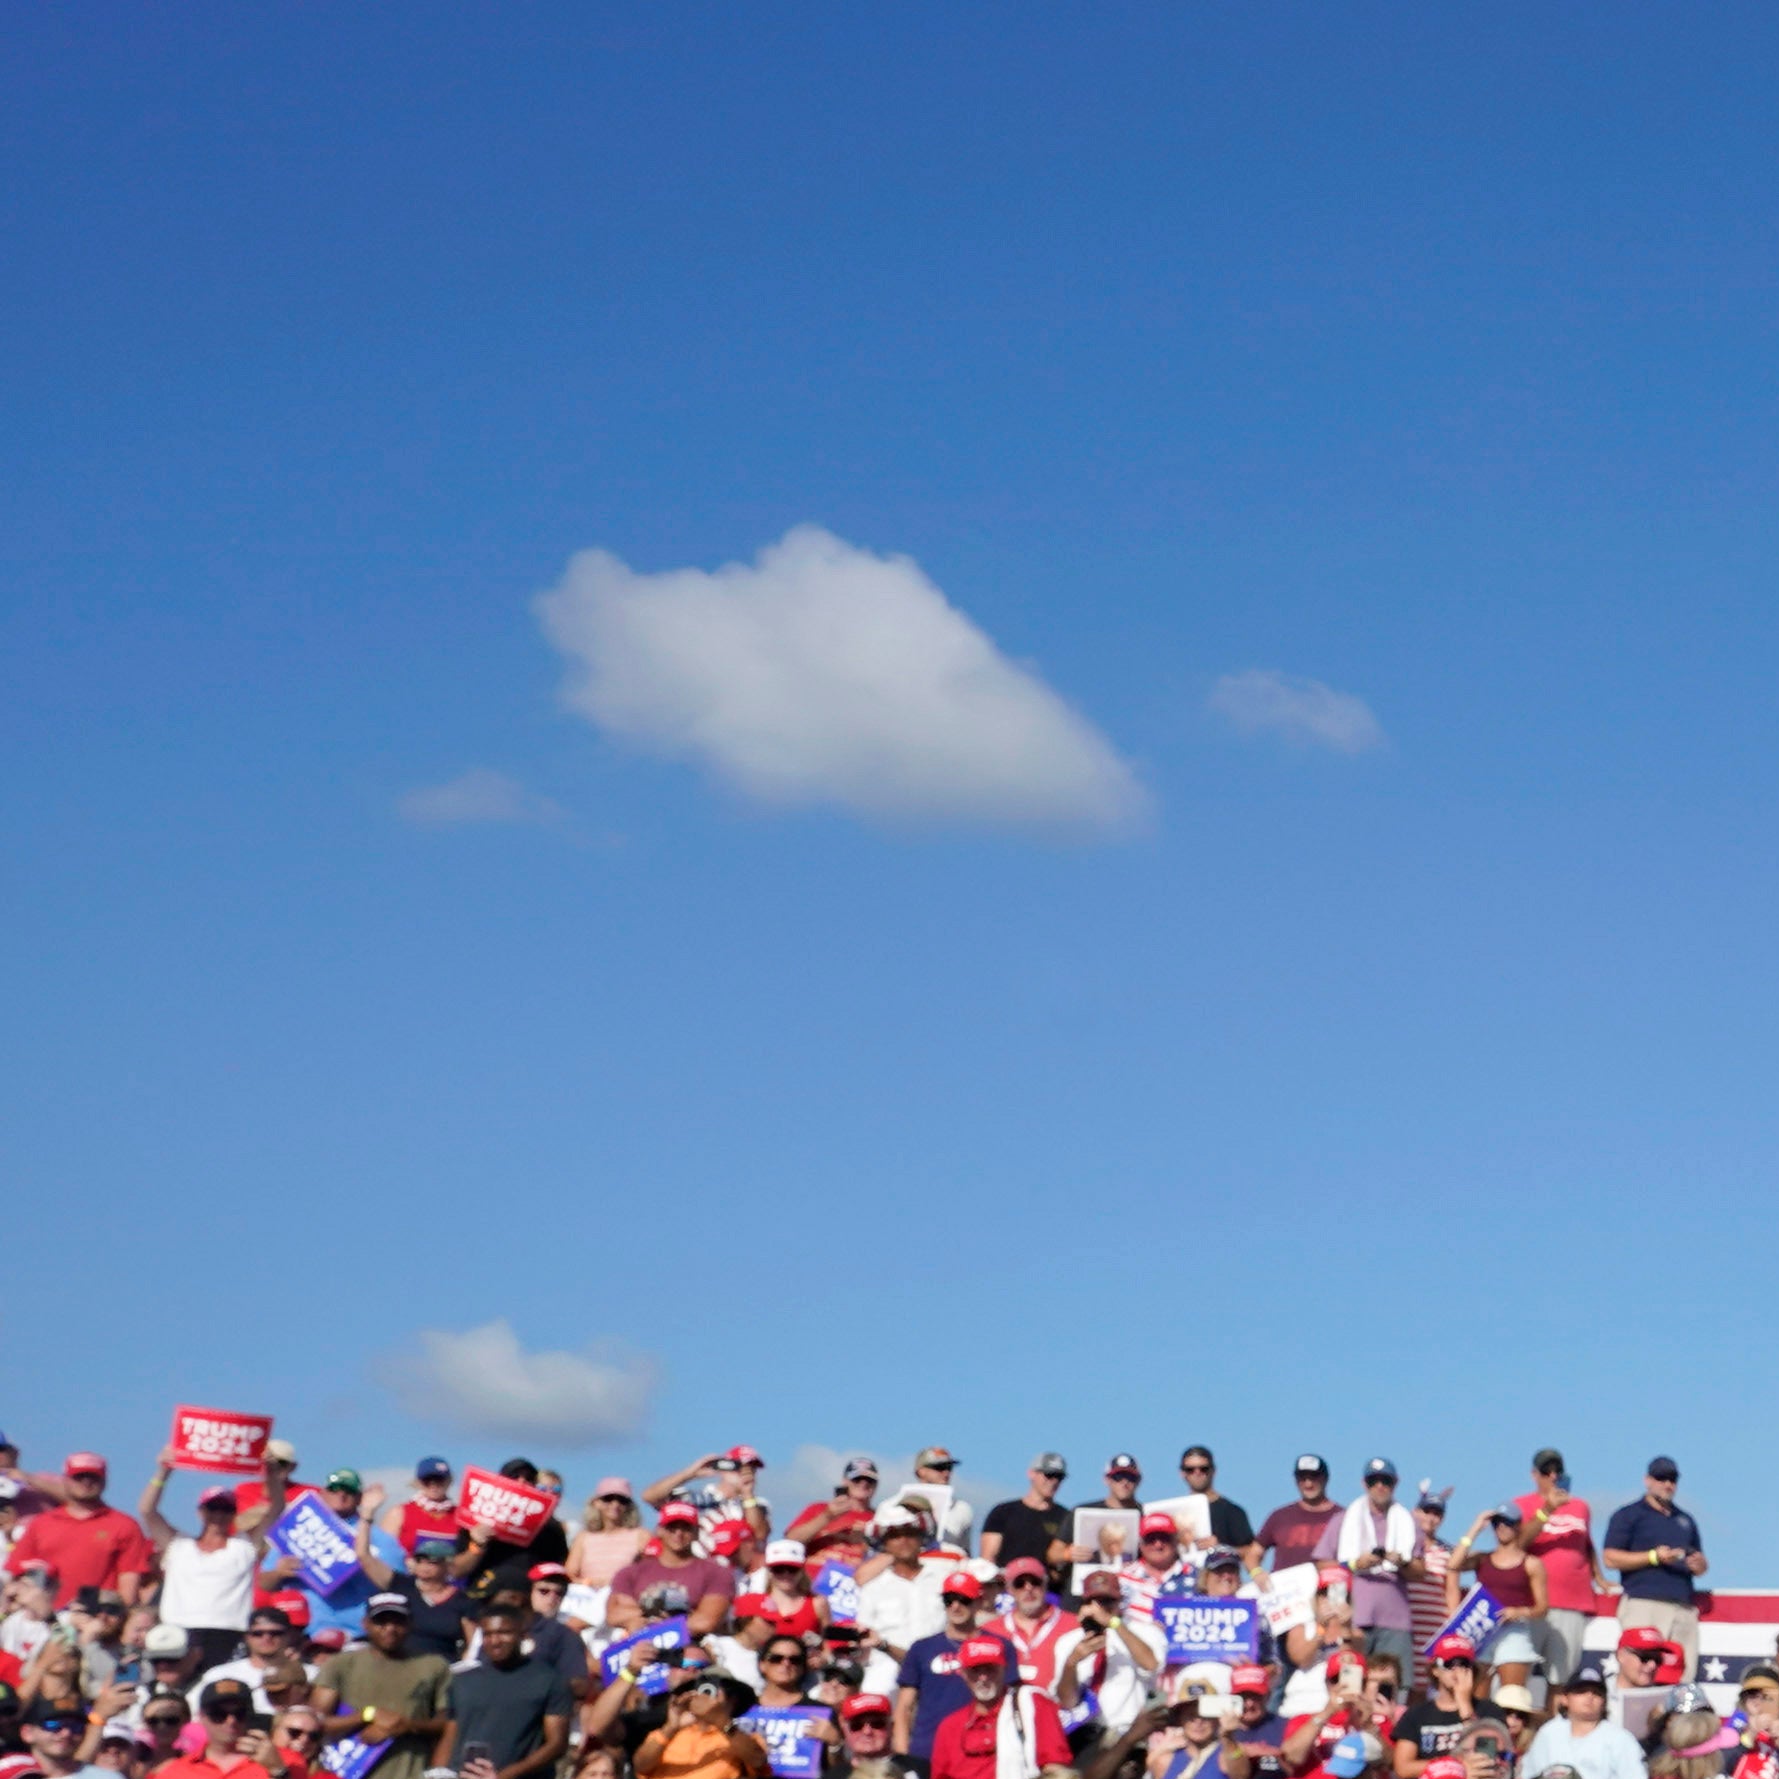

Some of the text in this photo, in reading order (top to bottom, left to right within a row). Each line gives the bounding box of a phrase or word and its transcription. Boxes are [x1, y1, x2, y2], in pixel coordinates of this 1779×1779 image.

[181, 1417, 265, 1442] TRUMP
[185, 1434, 249, 1456] 2024
[469, 1479, 545, 1516] TRUMP
[469, 1496, 525, 1526] 2024
[288, 1525, 335, 1569] 2024
[296, 1505, 357, 1564] TRUMP
[1161, 1607, 1249, 1627] TRUMP
[1173, 1624, 1237, 1643] 2024
